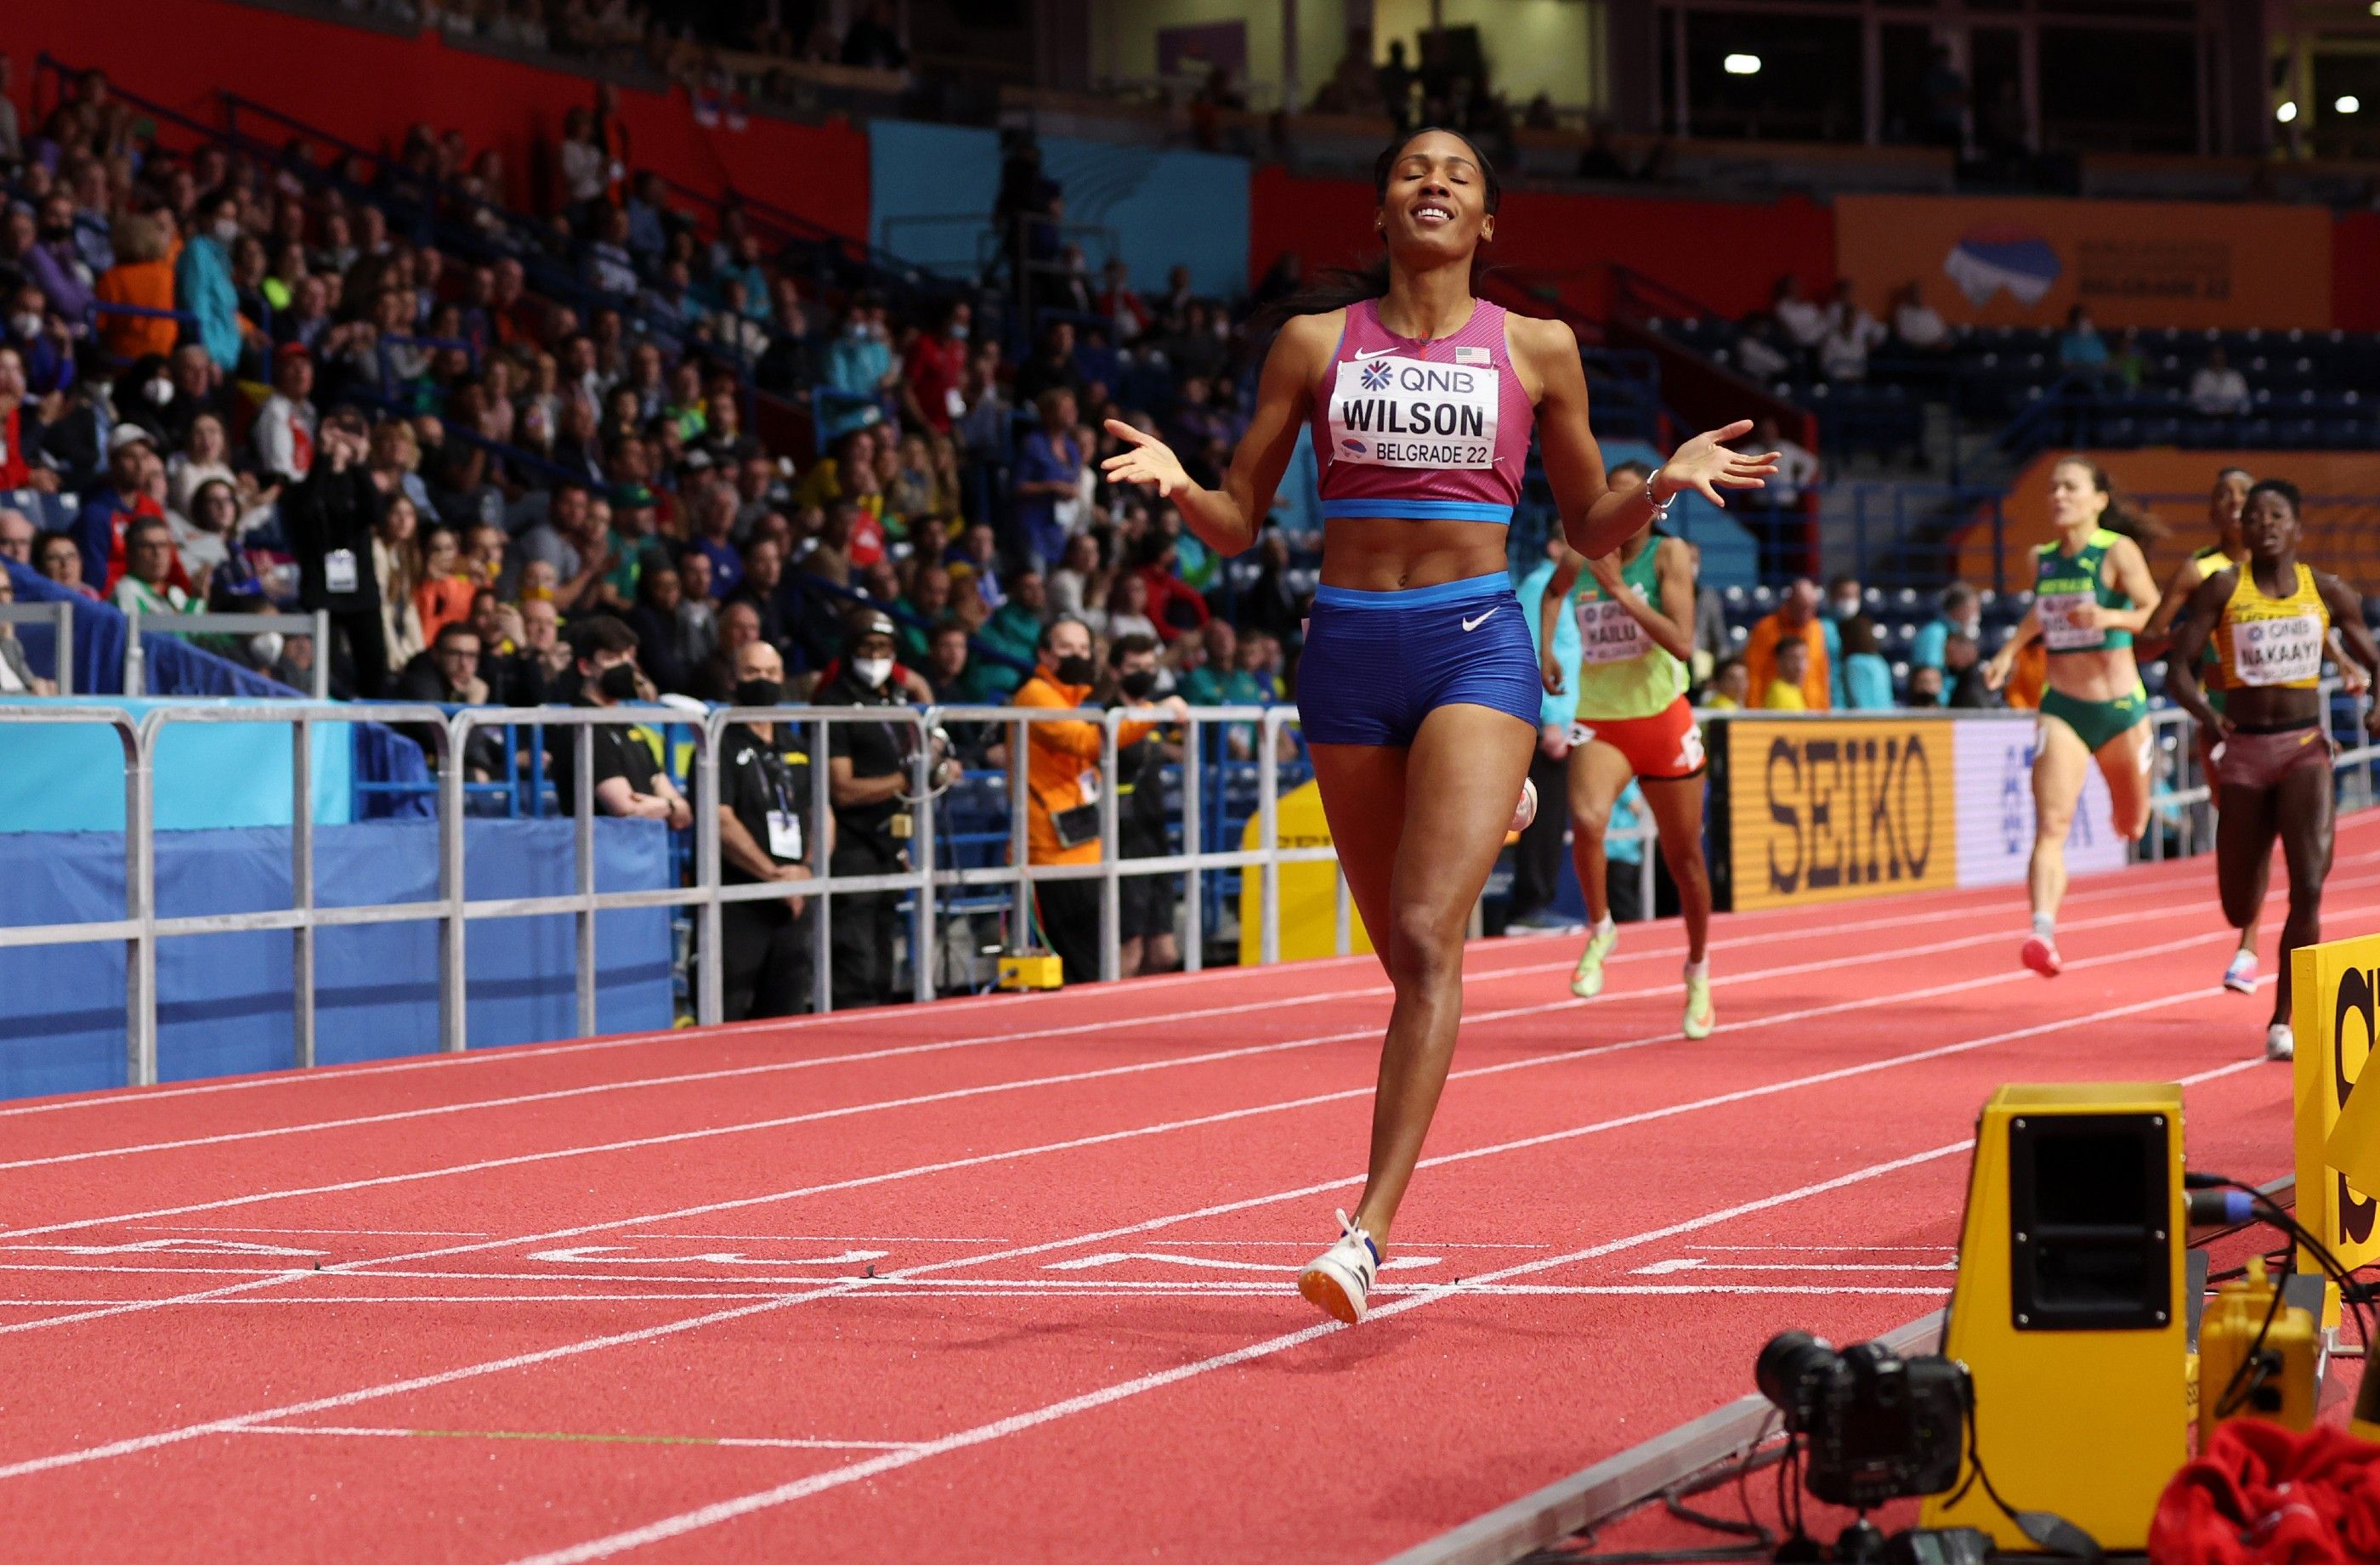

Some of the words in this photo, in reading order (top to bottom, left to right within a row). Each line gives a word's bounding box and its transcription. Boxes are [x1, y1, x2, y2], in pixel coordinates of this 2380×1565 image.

[1400, 366, 1475, 394] QNB
[1342, 399, 1483, 437] WILSON
[1377, 442, 1462, 463] BELGRADE
[1466, 446, 1488, 463] 22
[1766, 734, 1934, 895] SEIKO
[2335, 967, 2380, 1245] S
